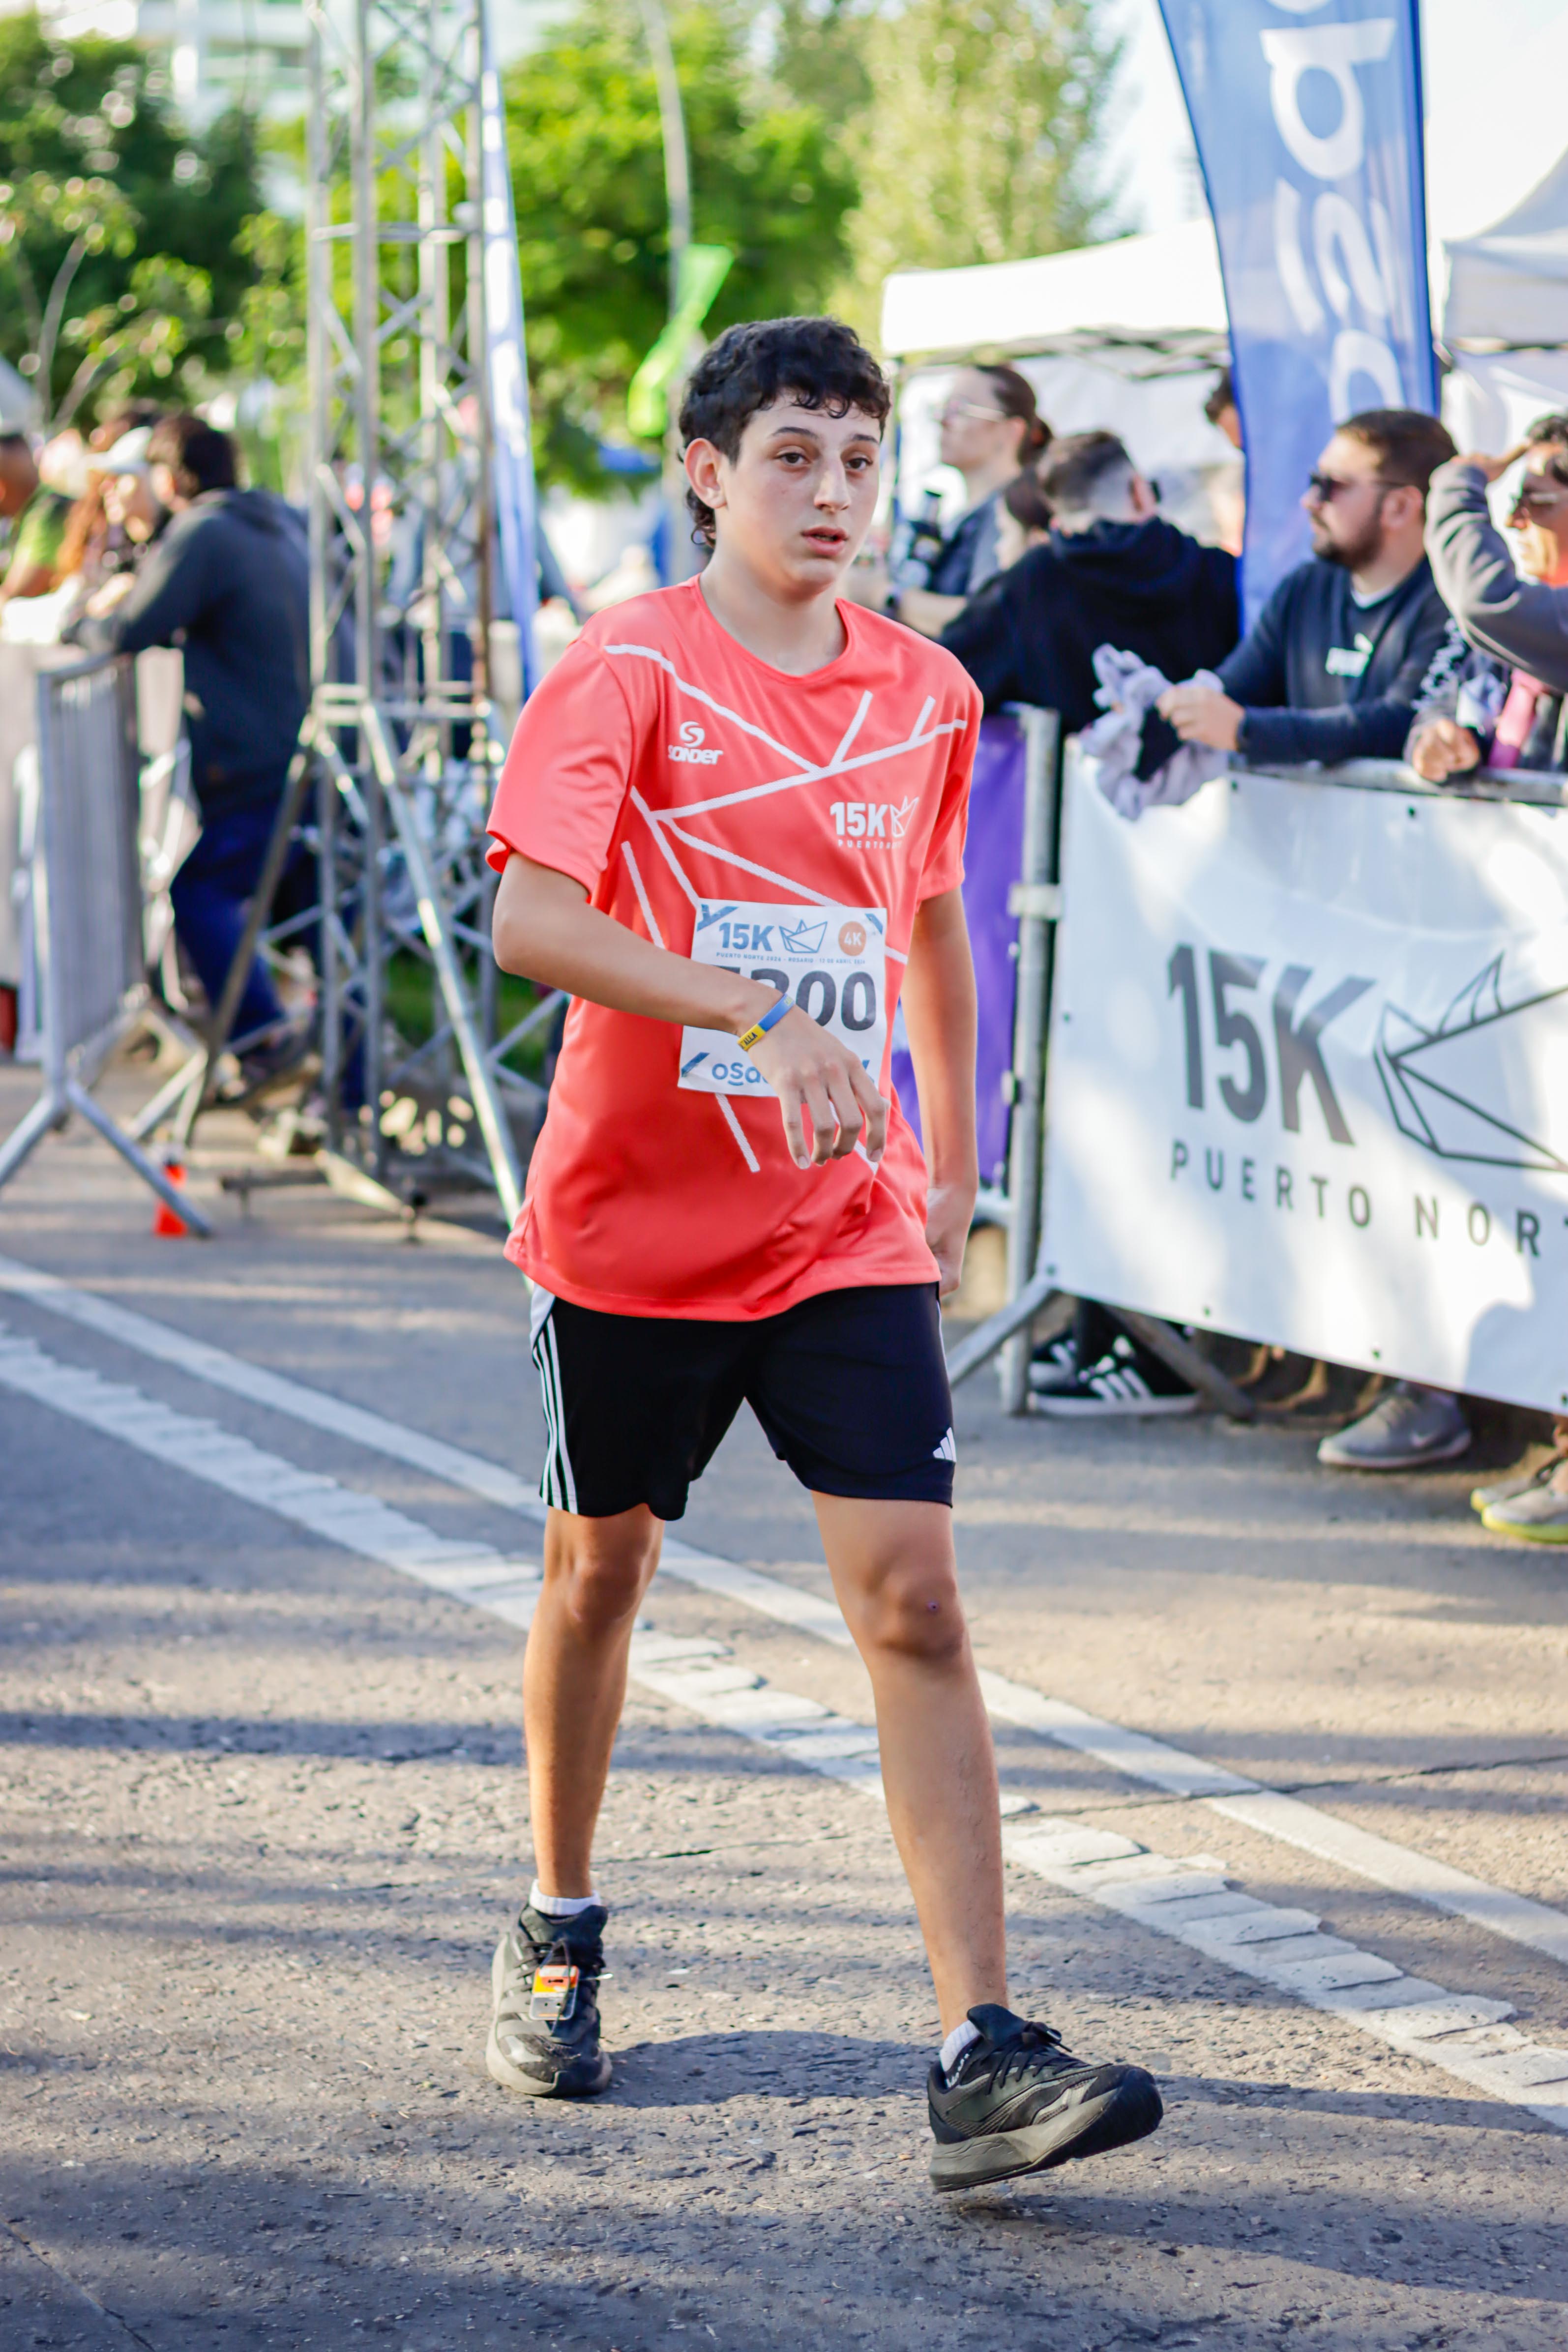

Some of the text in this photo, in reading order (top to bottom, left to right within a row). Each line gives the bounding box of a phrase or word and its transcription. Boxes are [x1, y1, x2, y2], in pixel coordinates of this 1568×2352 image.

[830, 802, 889, 838] 15K
[719, 922, 774, 951] 15K
[844, 932, 862, 945] 4K
[1169, 945, 1378, 1146] 15K
[1170, 1139, 1568, 1258] PUERTO NOR
